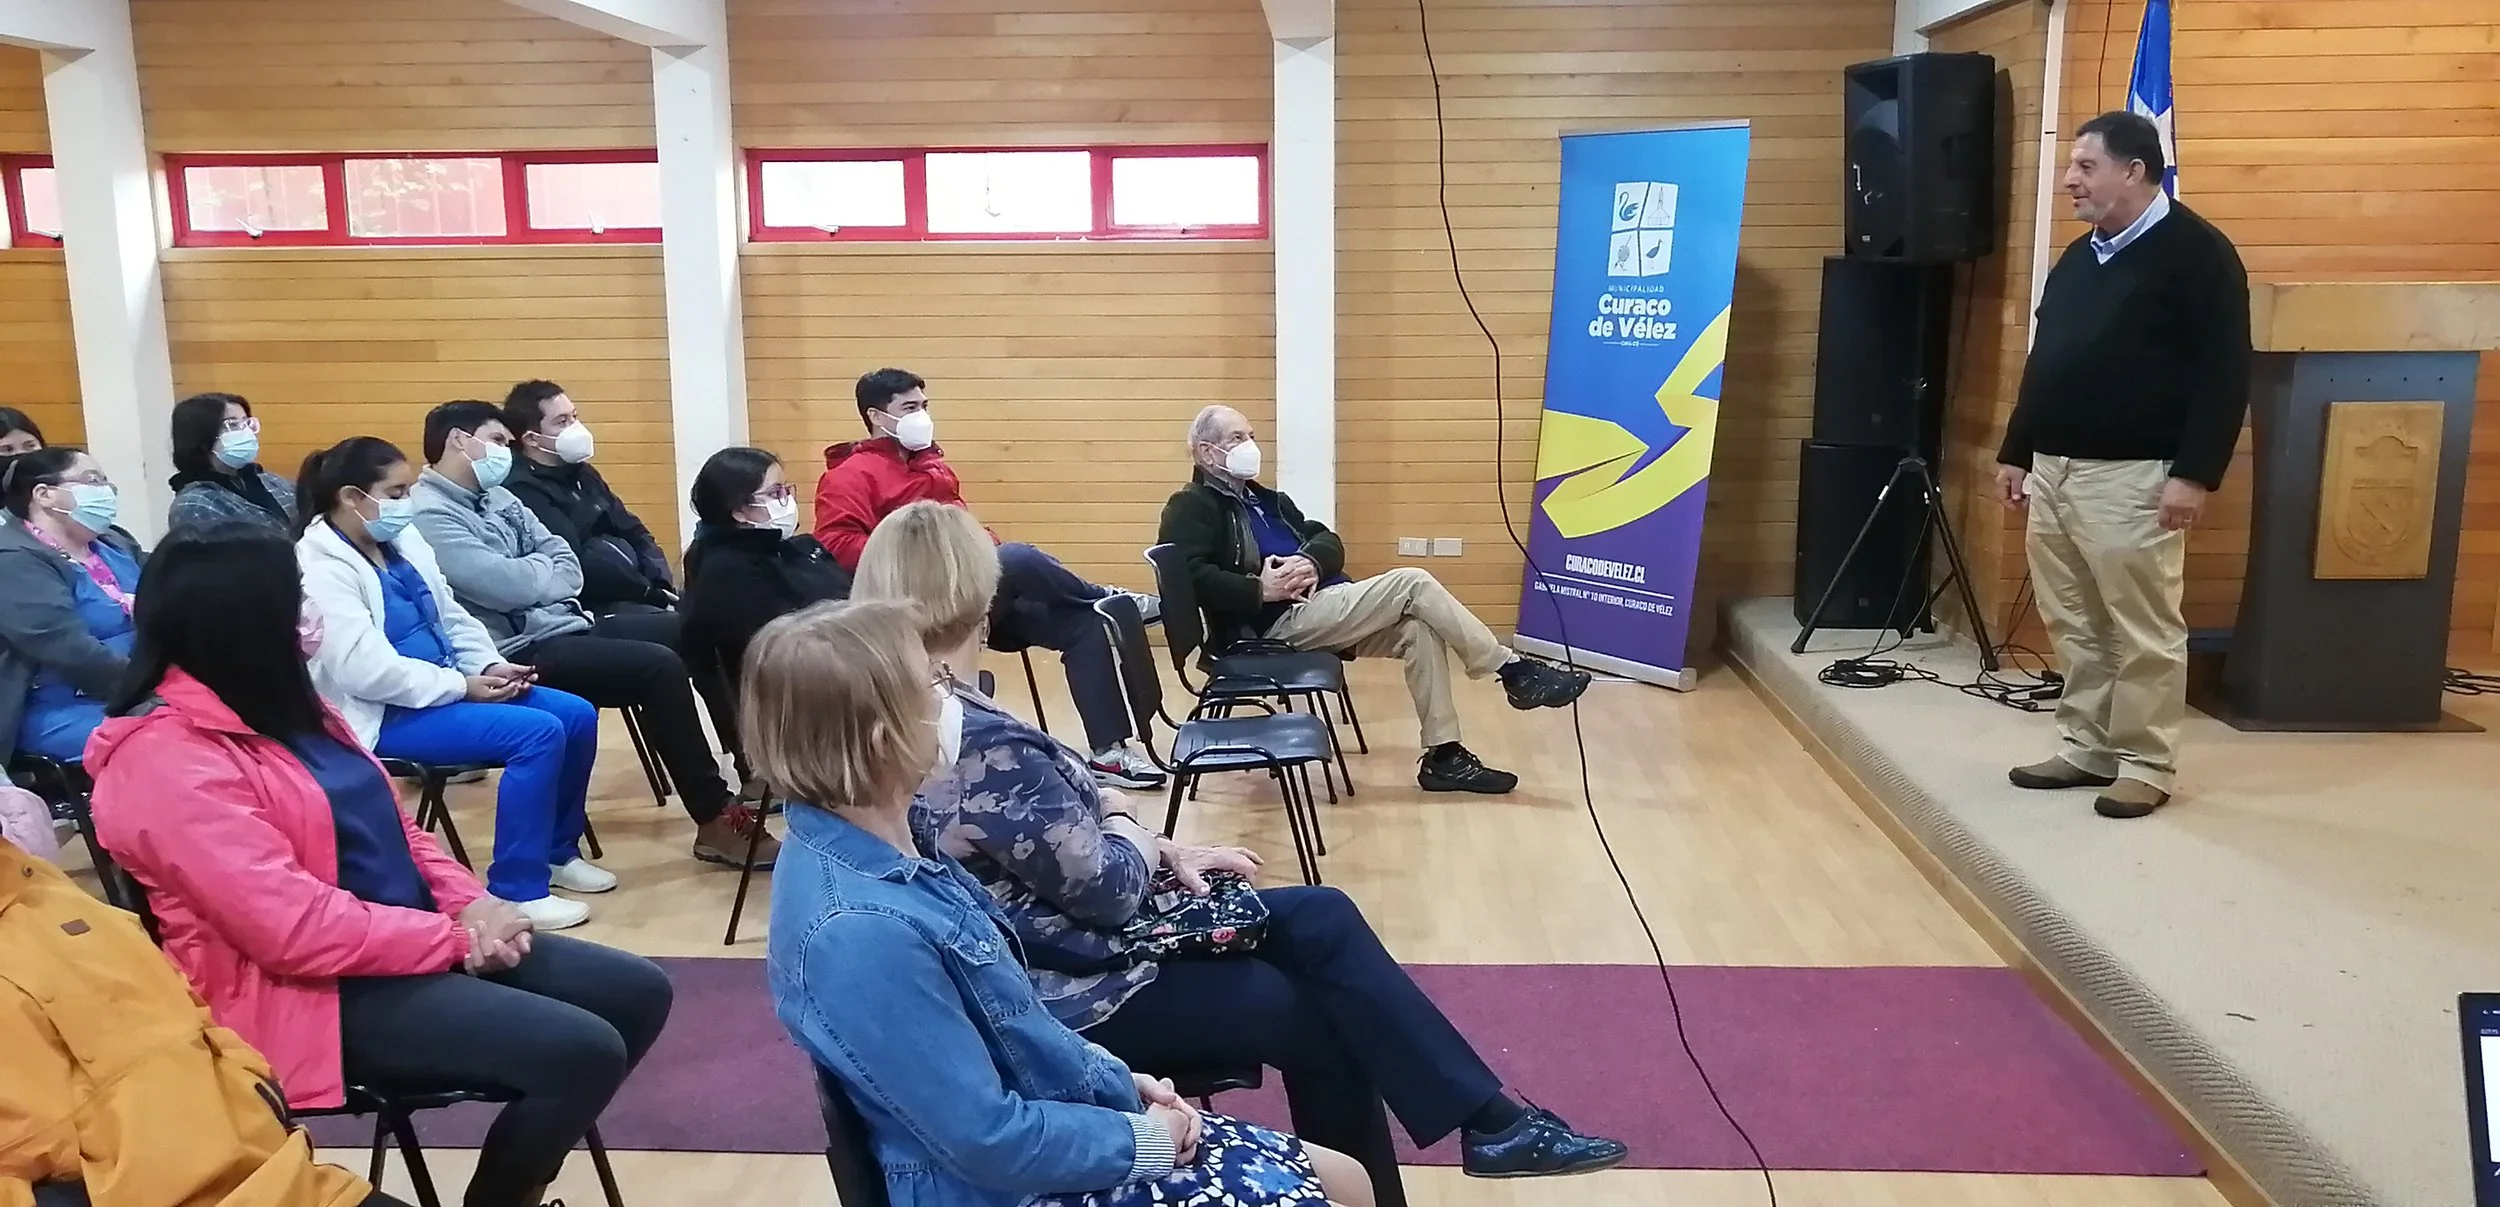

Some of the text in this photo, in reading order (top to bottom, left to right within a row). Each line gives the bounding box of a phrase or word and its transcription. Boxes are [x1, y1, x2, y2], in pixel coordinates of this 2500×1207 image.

[1608, 284, 1665, 293] MUNICIPALIDAD
[1598, 293, 1672, 316] Curaco
[1588, 315, 1677, 340] de Vélez
[1565, 554, 1646, 584] CURACODEVELEZ.CL
[1560, 585, 1583, 599] MISTRAL
[1624, 598, 1648, 611] CURACO
